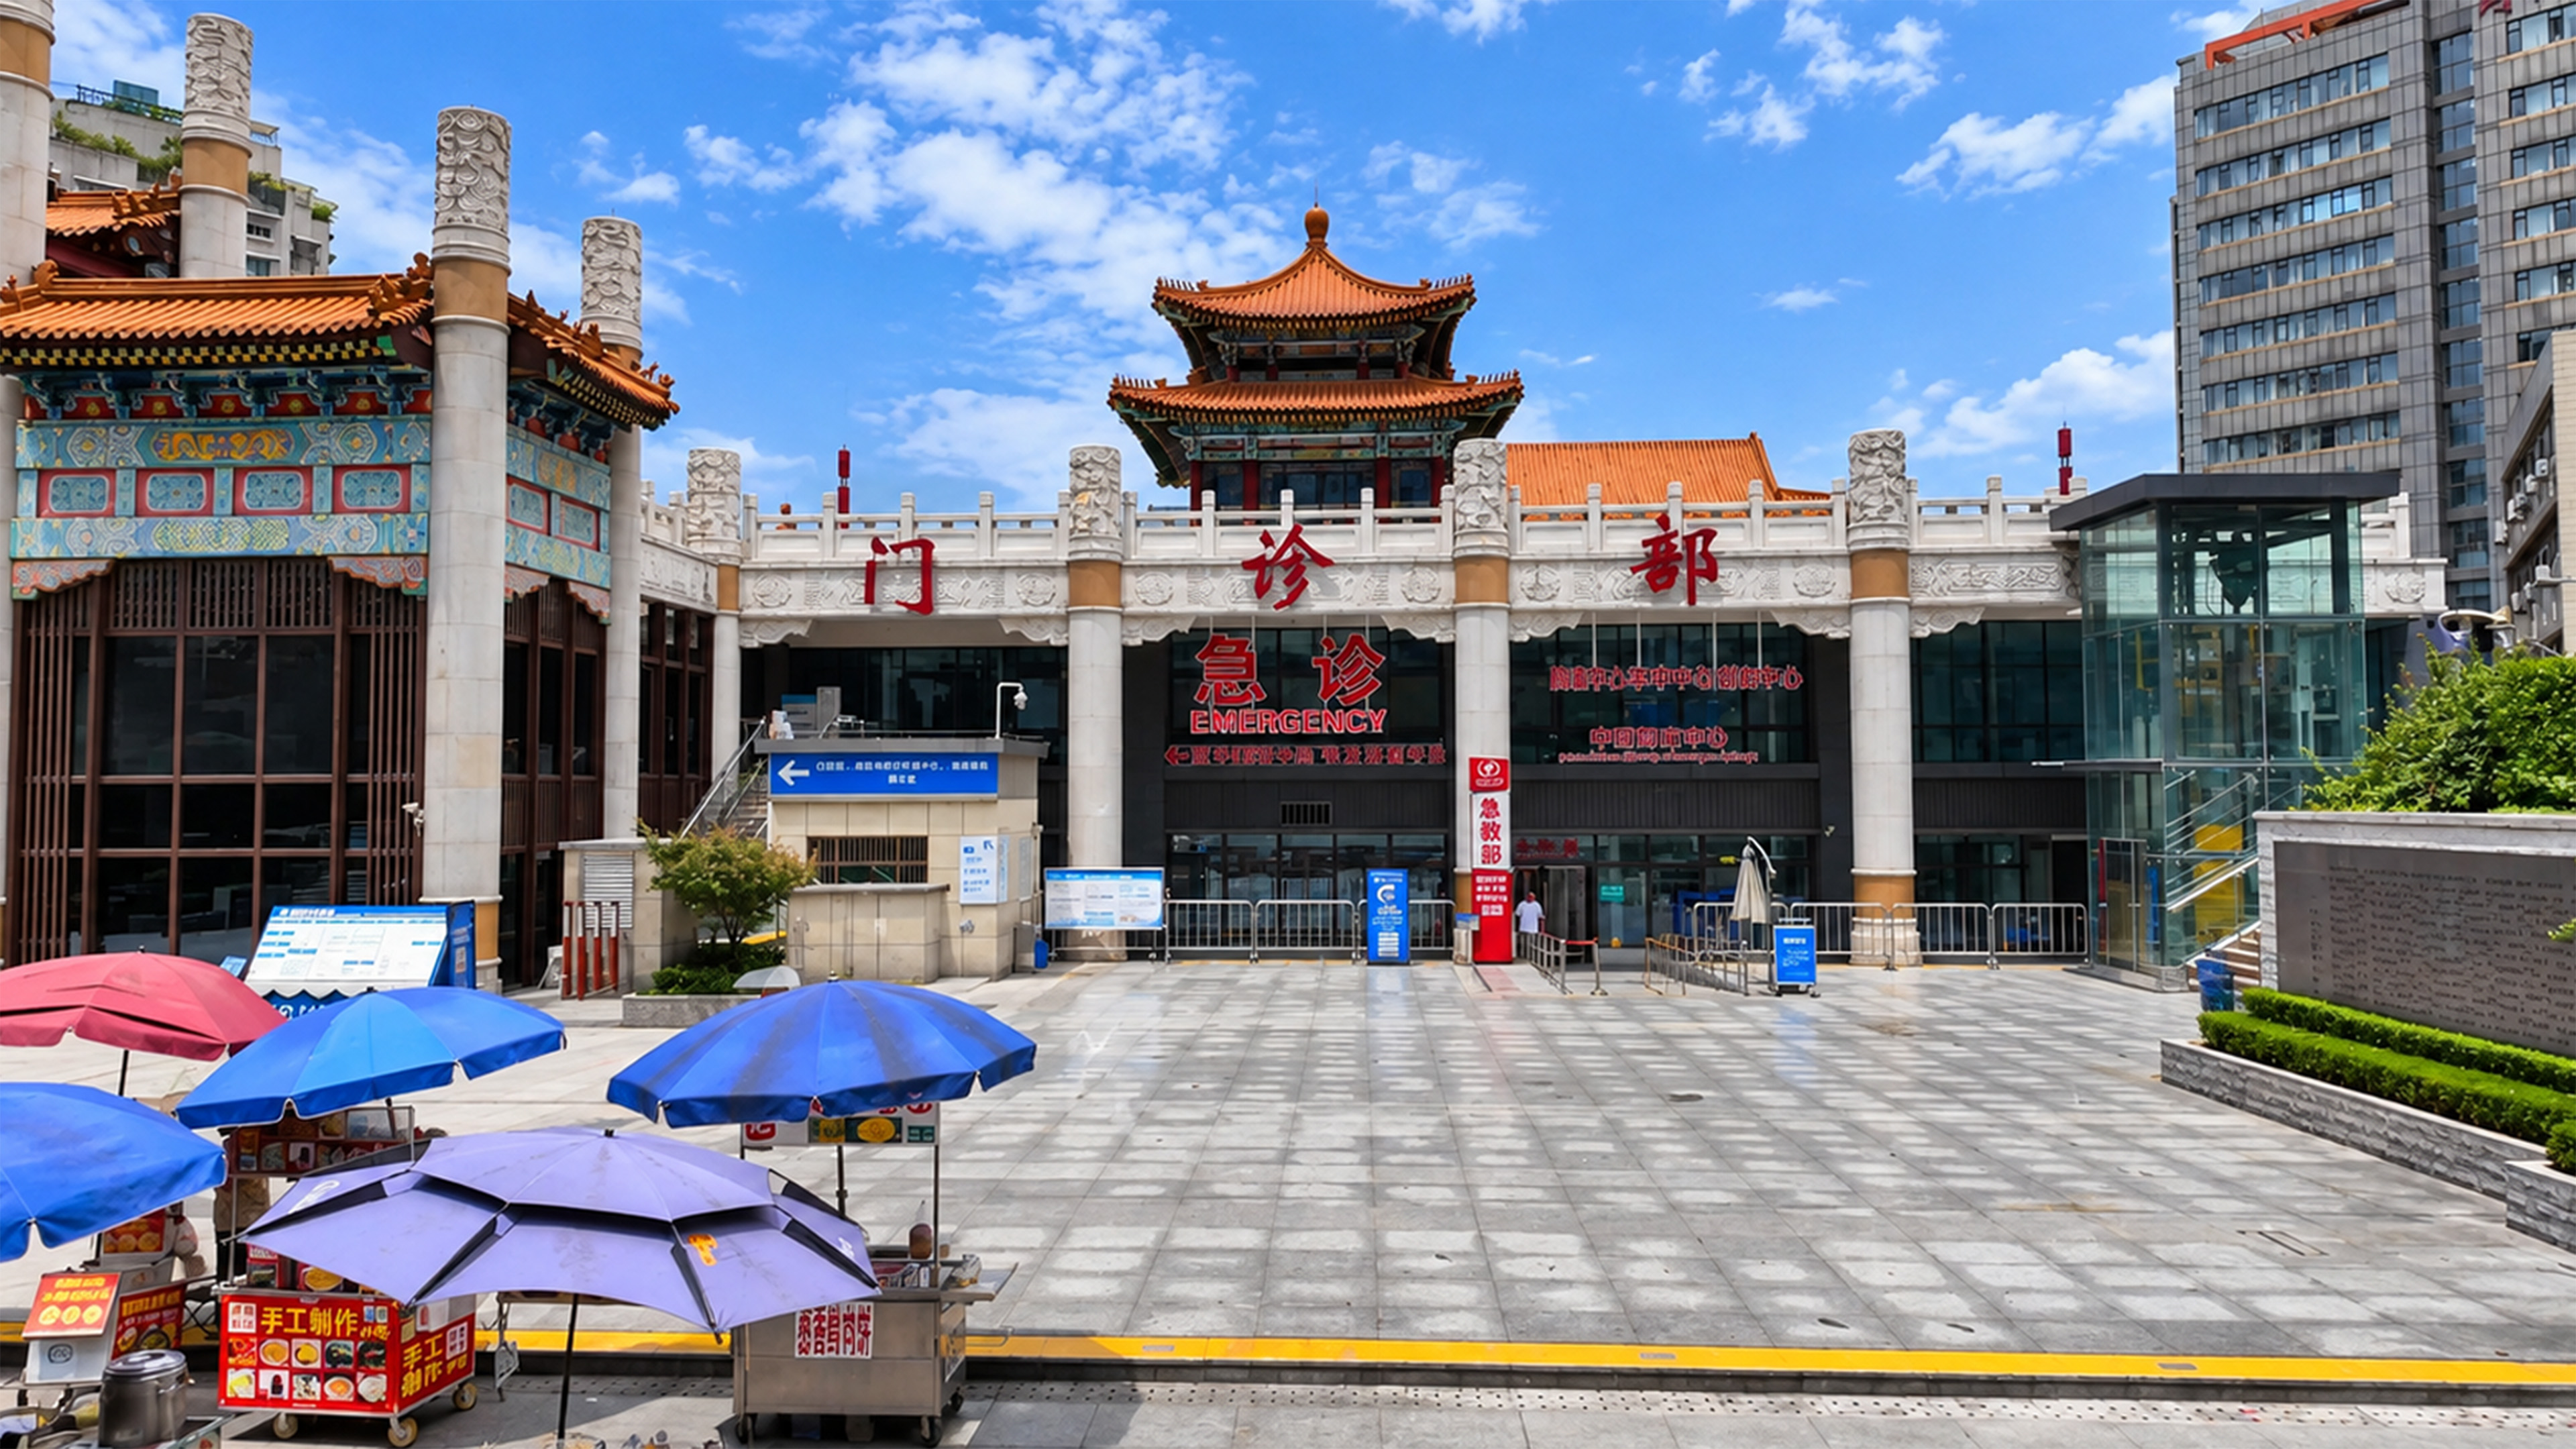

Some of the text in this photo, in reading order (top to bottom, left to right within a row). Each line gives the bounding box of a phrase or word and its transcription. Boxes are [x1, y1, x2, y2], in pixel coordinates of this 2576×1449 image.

[864, 513, 1718, 615] 门诊部
[1194, 633, 1386, 706] 急诊
[1190, 708, 1387, 734] EMERGENCY
